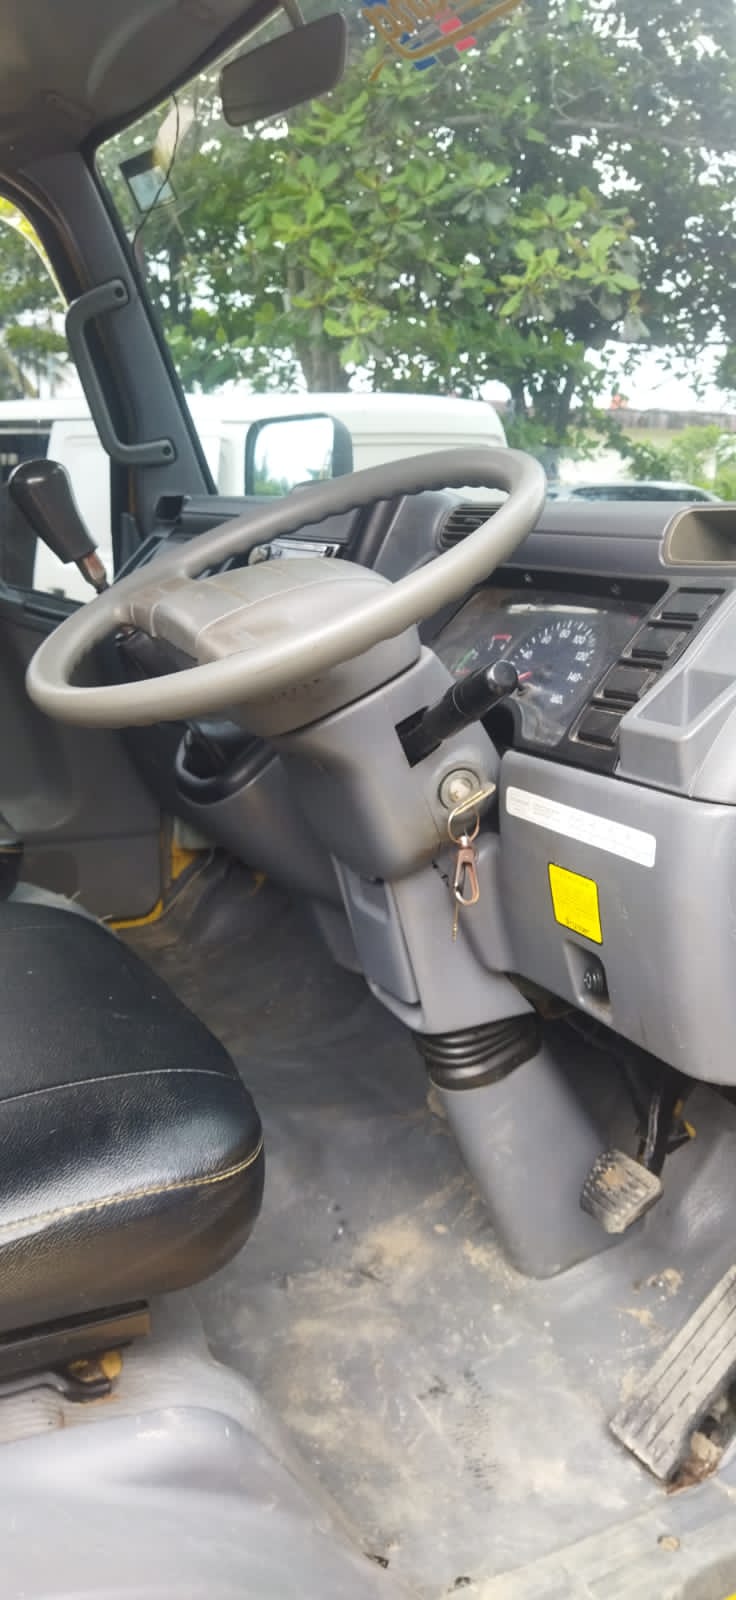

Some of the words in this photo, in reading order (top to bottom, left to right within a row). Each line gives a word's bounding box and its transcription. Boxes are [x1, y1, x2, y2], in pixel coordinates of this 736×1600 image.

[572, 635, 586, 645] 100
[575, 651, 589, 662] 120
[567, 672, 581, 683] 140
